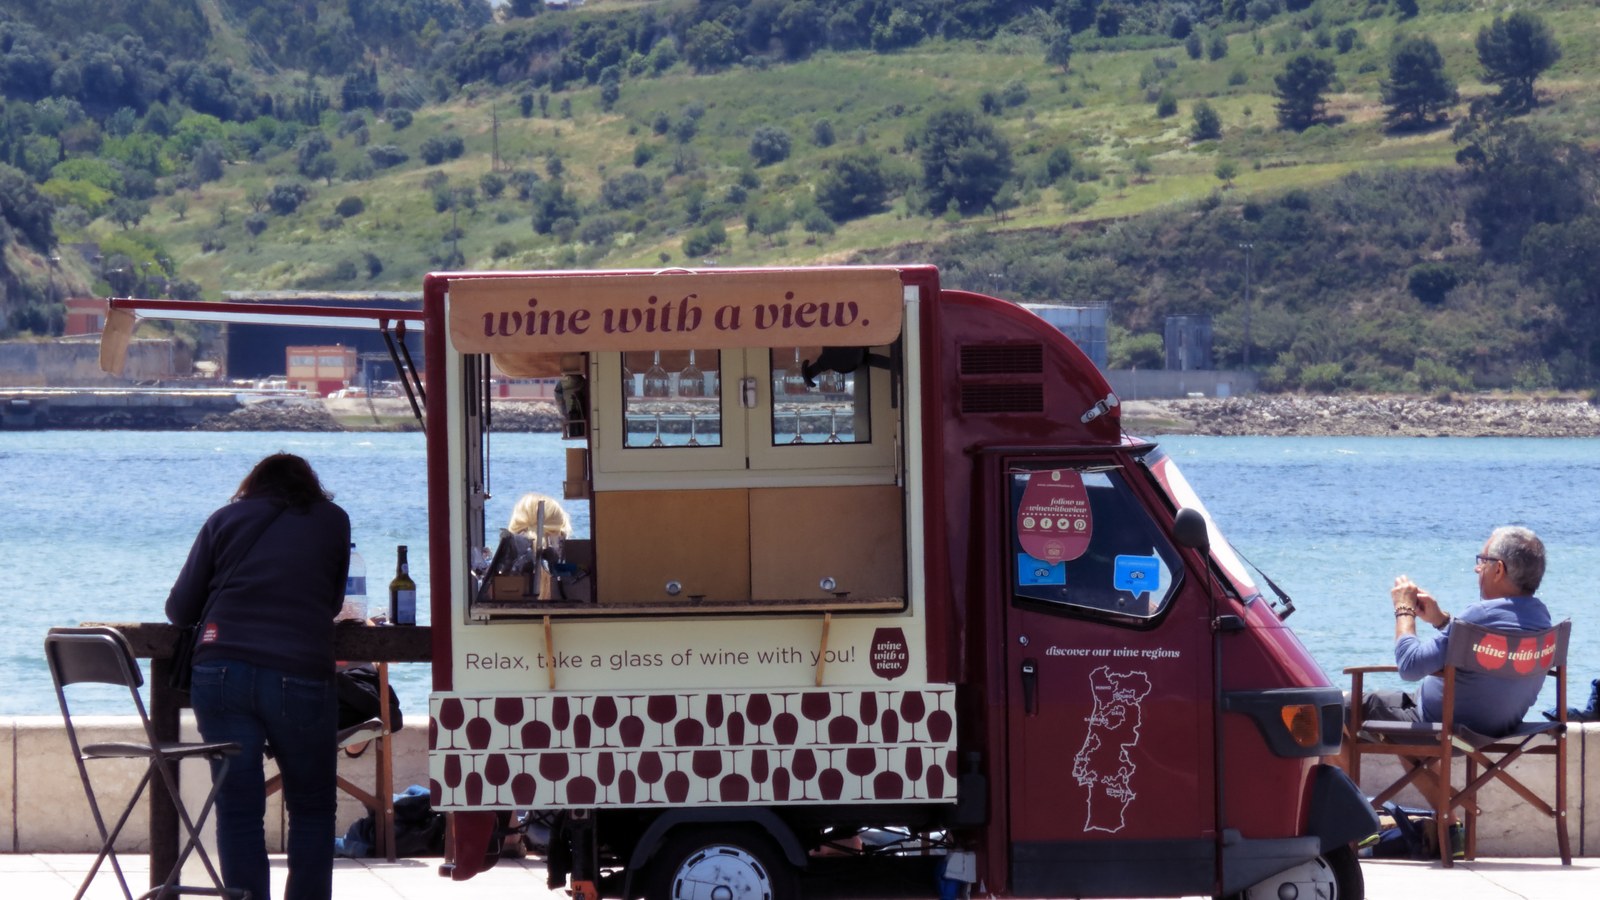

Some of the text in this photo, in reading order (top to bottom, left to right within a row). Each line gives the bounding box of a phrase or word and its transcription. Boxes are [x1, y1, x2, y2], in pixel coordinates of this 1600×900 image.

[482, 291, 870, 337] wine with a view.
[1050, 497, 1075, 506] follow
[877, 641, 902, 650] wine
[874, 650, 897, 660] with
[1046, 646, 1180, 660] discover our wine regions
[1472, 643, 1506, 659] wine
[1507, 649, 1533, 661] with
[1533, 651, 1540, 660] a
[466, 652, 529, 671] Relax,
[590, 655, 602, 668] a
[609, 650, 663, 671] glass
[671, 648, 692, 666] of
[699, 648, 749, 665] wine
[757, 646, 802, 664] with
[810, 646, 855, 667] you!
[876, 660, 903, 670] view.
